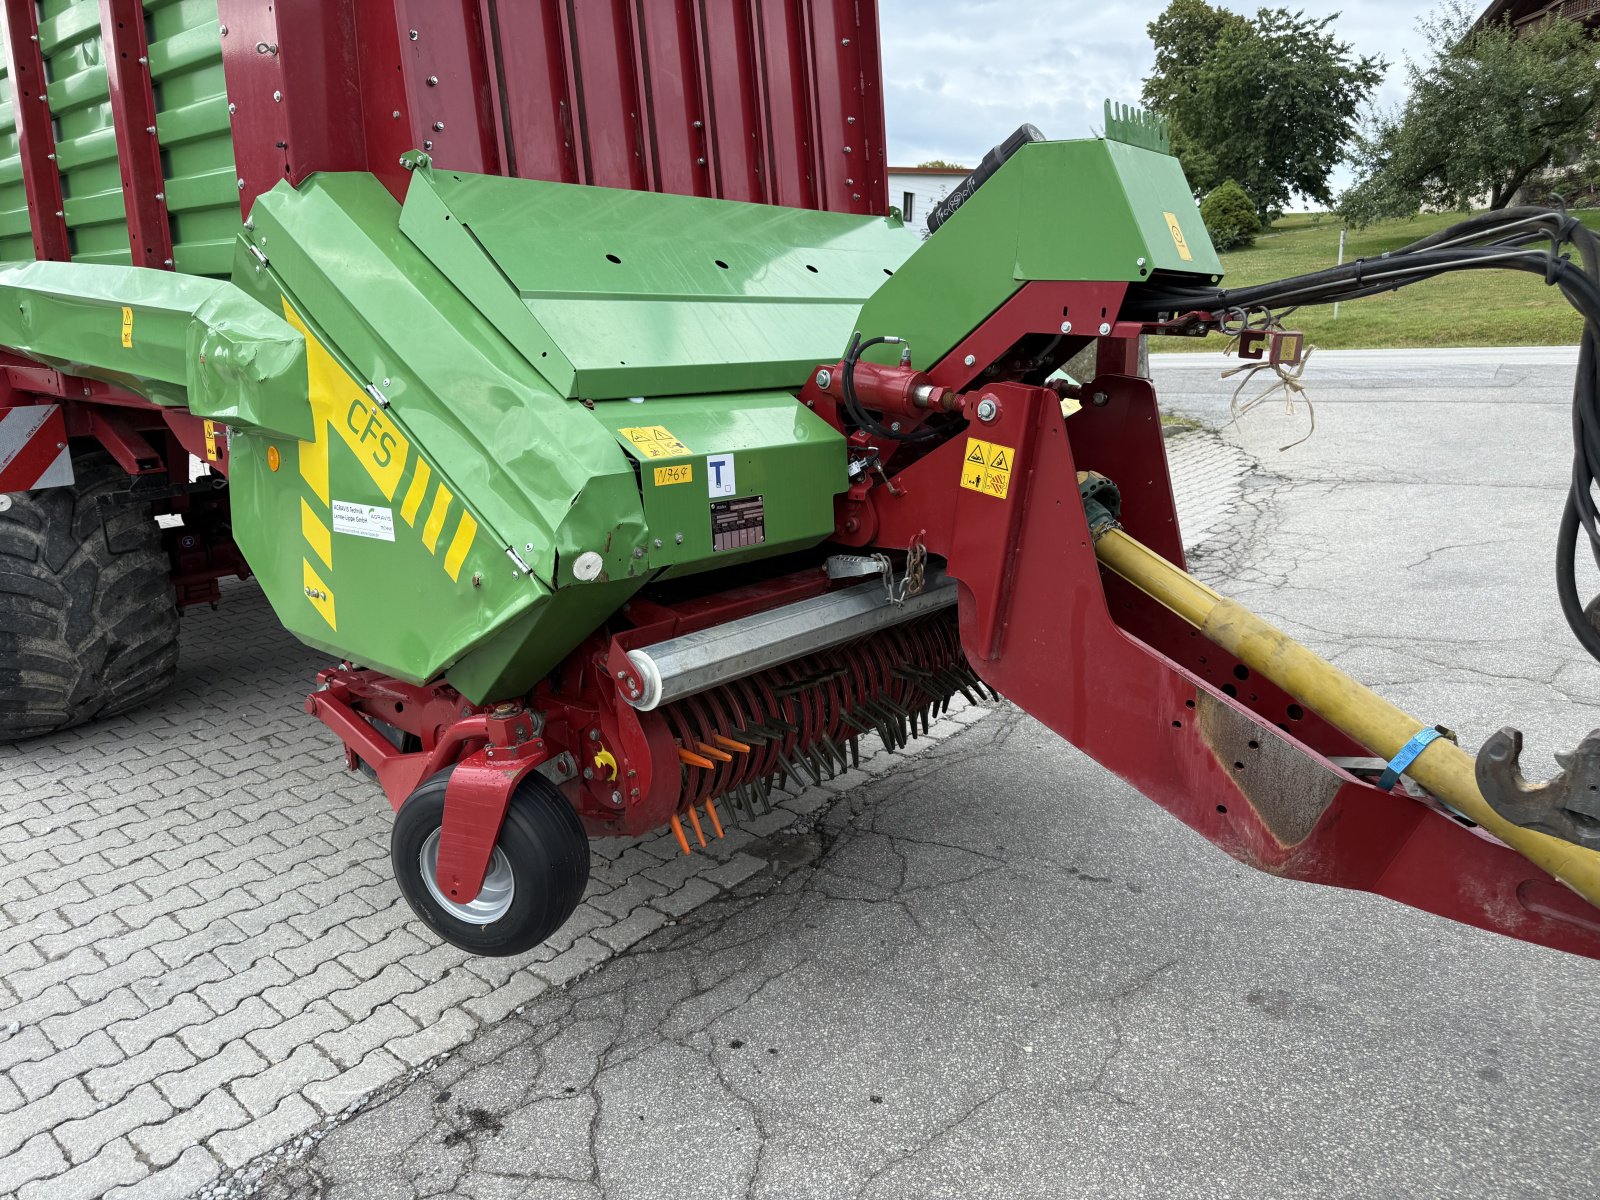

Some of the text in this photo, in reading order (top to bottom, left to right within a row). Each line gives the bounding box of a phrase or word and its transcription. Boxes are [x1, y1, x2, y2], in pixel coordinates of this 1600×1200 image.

[26, 425, 37, 438] GEKA
[347, 399, 397, 467] CFS
[710, 461, 725, 488] T
[370, 514, 391, 522] AGRAVIS
